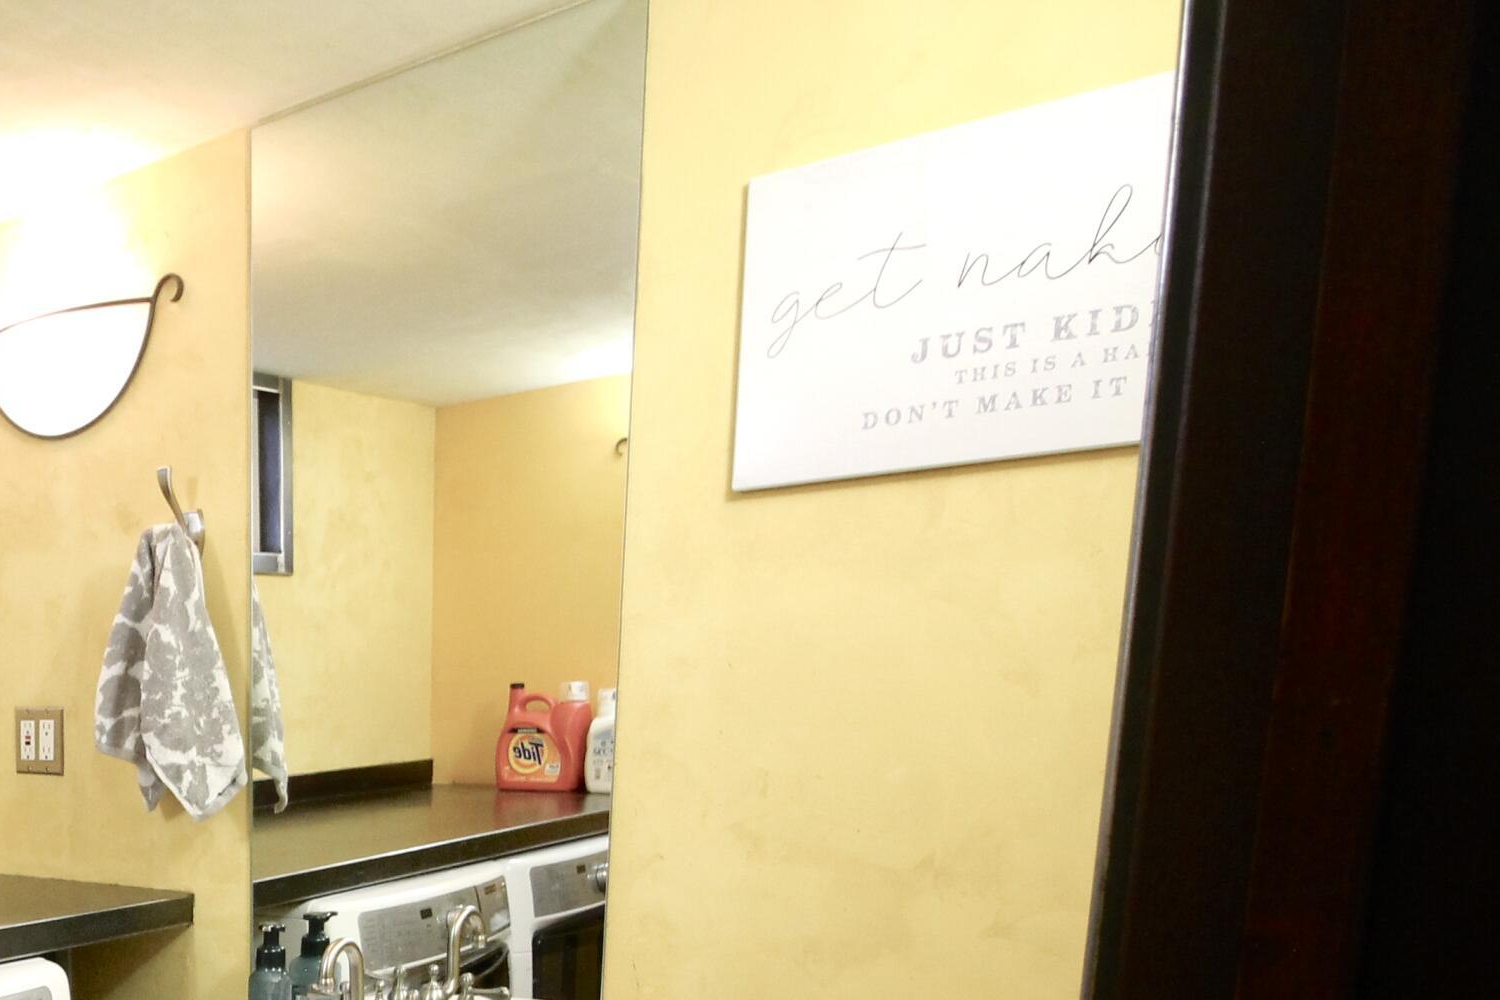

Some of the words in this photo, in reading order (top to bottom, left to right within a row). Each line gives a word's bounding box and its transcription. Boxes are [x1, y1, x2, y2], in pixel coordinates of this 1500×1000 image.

[766, 231, 927, 359] get
[910, 321, 1026, 364] JUST
[1050, 300, 1156, 342] KID
[954, 360, 1016, 385] THIS
[1030, 355, 1057, 374] IS
[1071, 352, 1087, 369] A
[1101, 343, 1150, 364] HA
[861, 399, 959, 431] DON'T
[975, 384, 1073, 415] MAKE
[1091, 376, 1127, 399] IT
